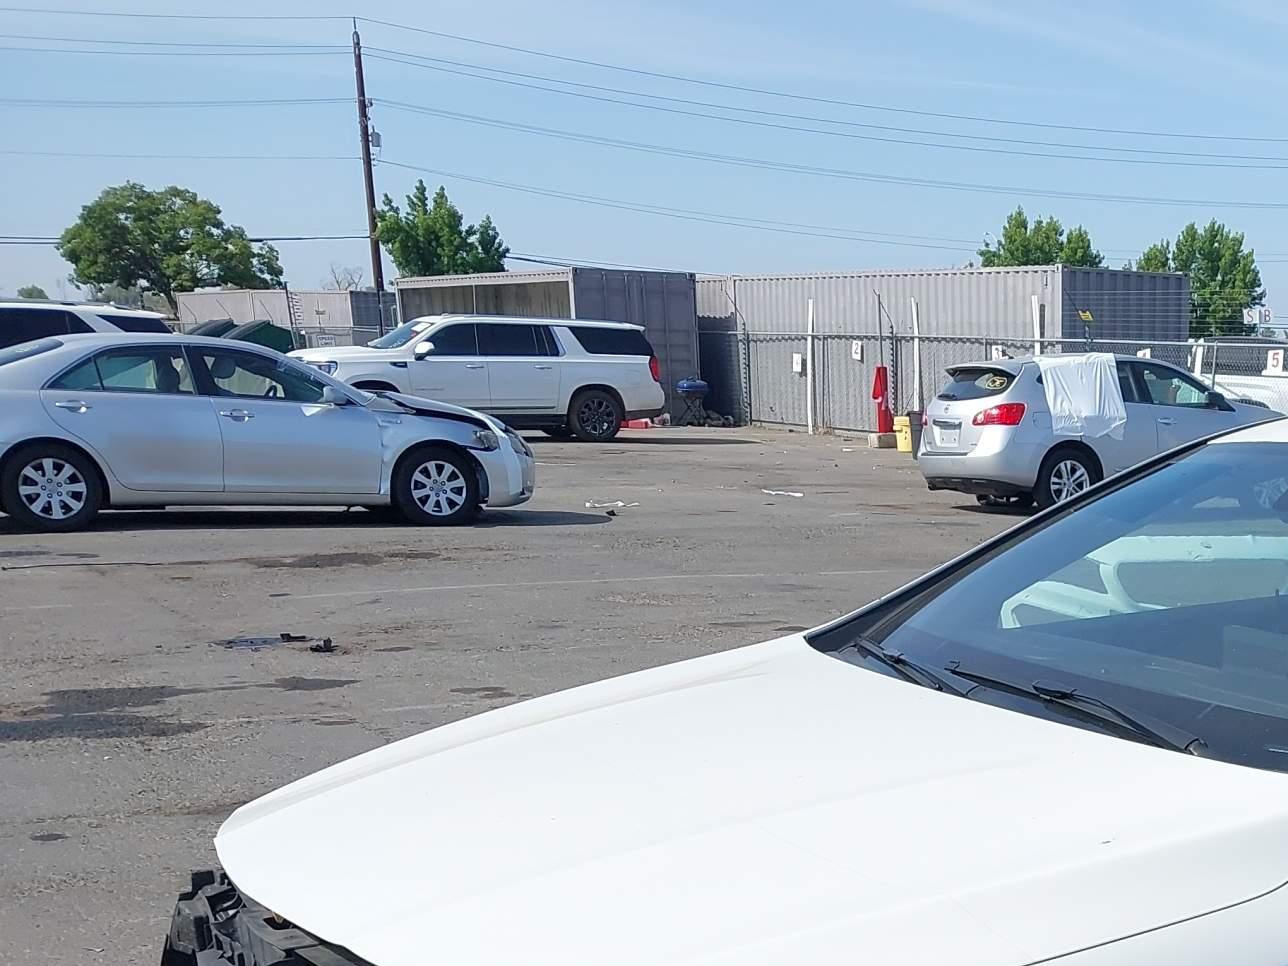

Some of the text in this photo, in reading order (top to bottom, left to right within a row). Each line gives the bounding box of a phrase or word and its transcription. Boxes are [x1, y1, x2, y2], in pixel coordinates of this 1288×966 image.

[1246, 309, 1254, 323] S
[1263, 309, 1271, 323] B
[853, 342, 859, 355] 2
[1271, 351, 1280, 368] 5
